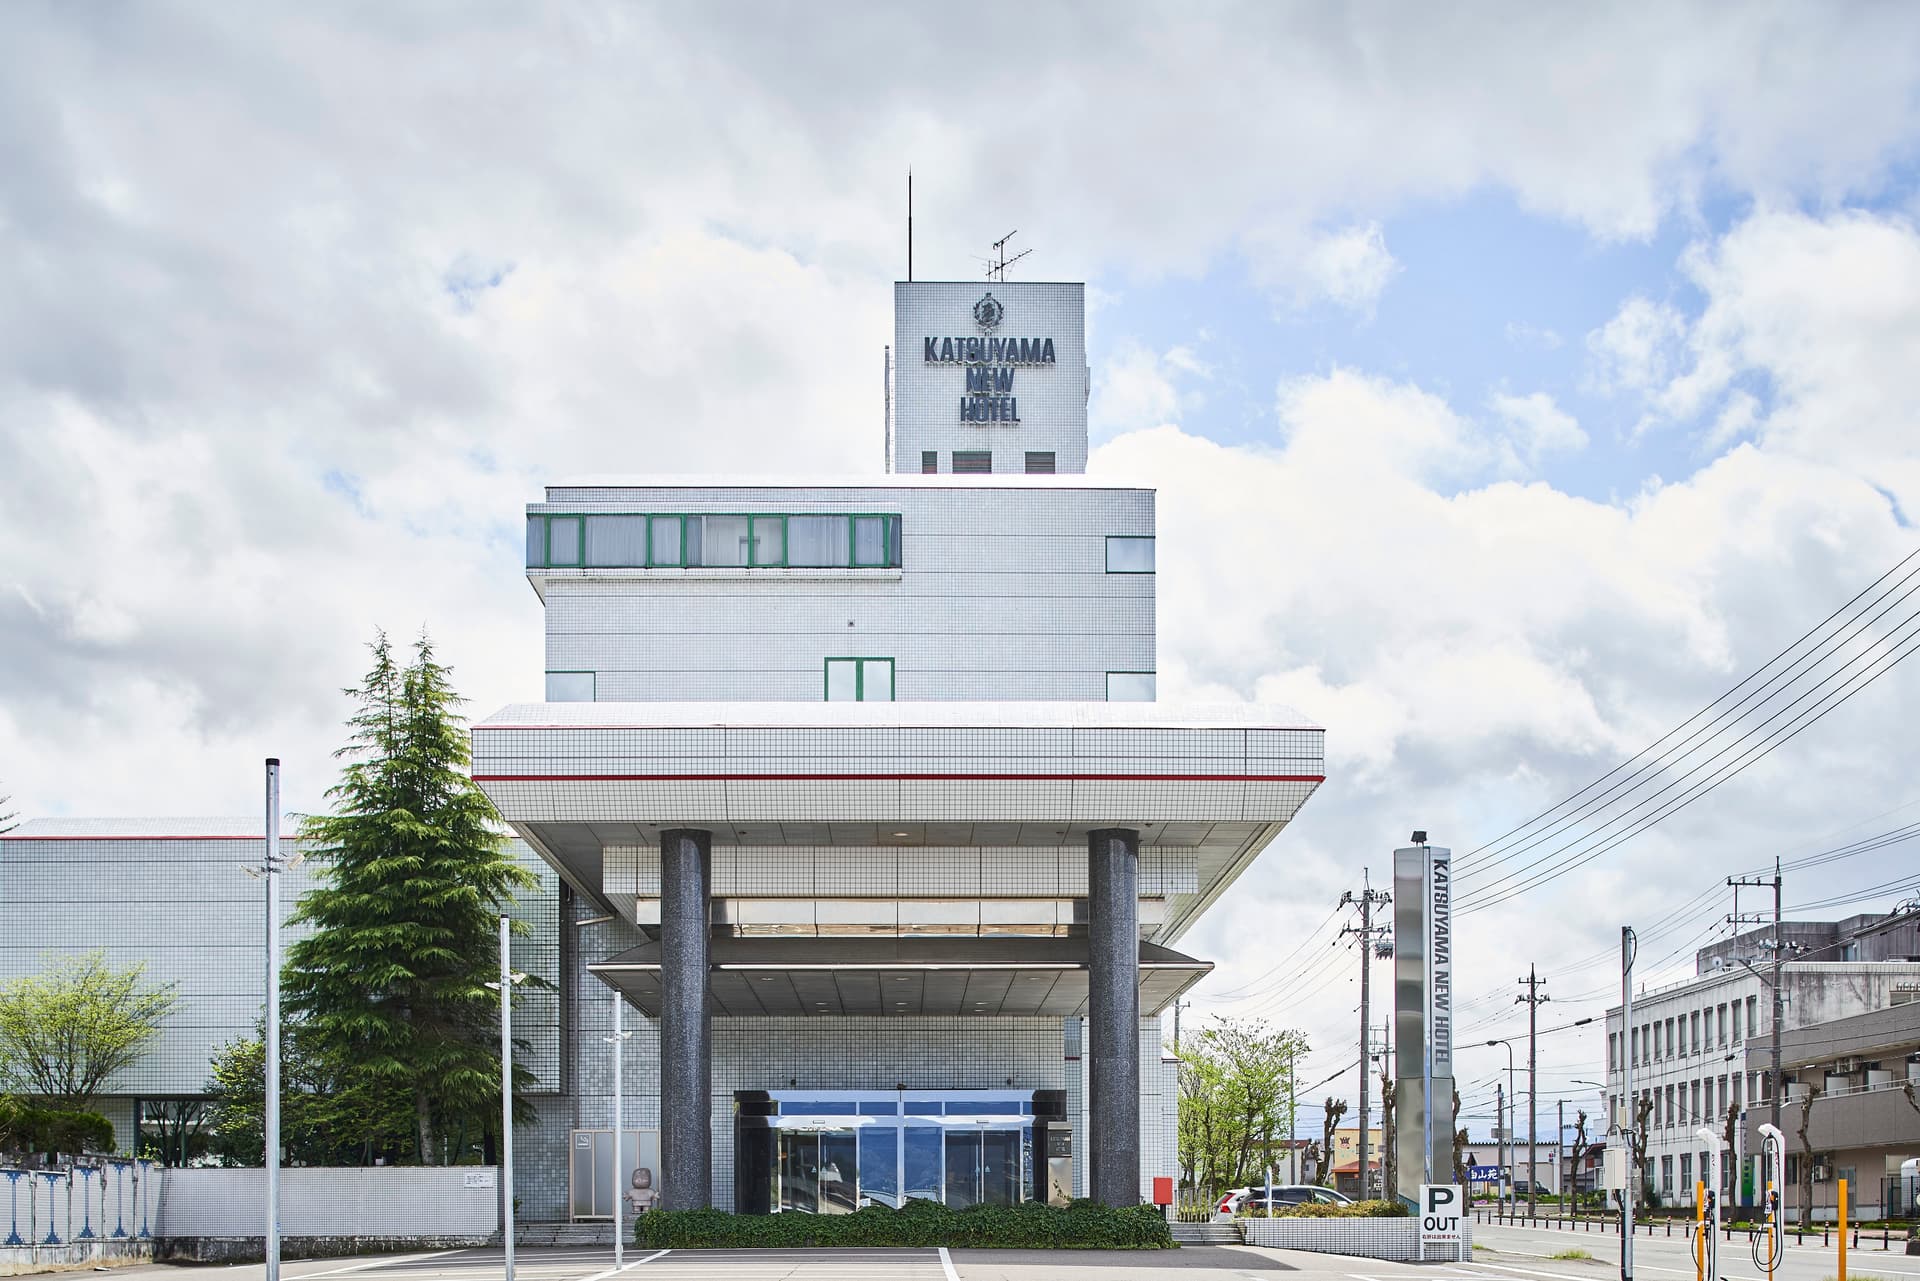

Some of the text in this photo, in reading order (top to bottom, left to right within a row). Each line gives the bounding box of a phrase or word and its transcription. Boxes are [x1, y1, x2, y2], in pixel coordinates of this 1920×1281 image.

[924, 336, 1056, 364] KATSUYAMA
[966, 367, 1015, 393] NEW
[960, 396, 1021, 423] HOTEL
[1434, 859, 1450, 1066] KATSUYAMA NEW HOTEL
[1428, 1187, 1454, 1213] P
[1424, 1216, 1459, 1231] OUT
